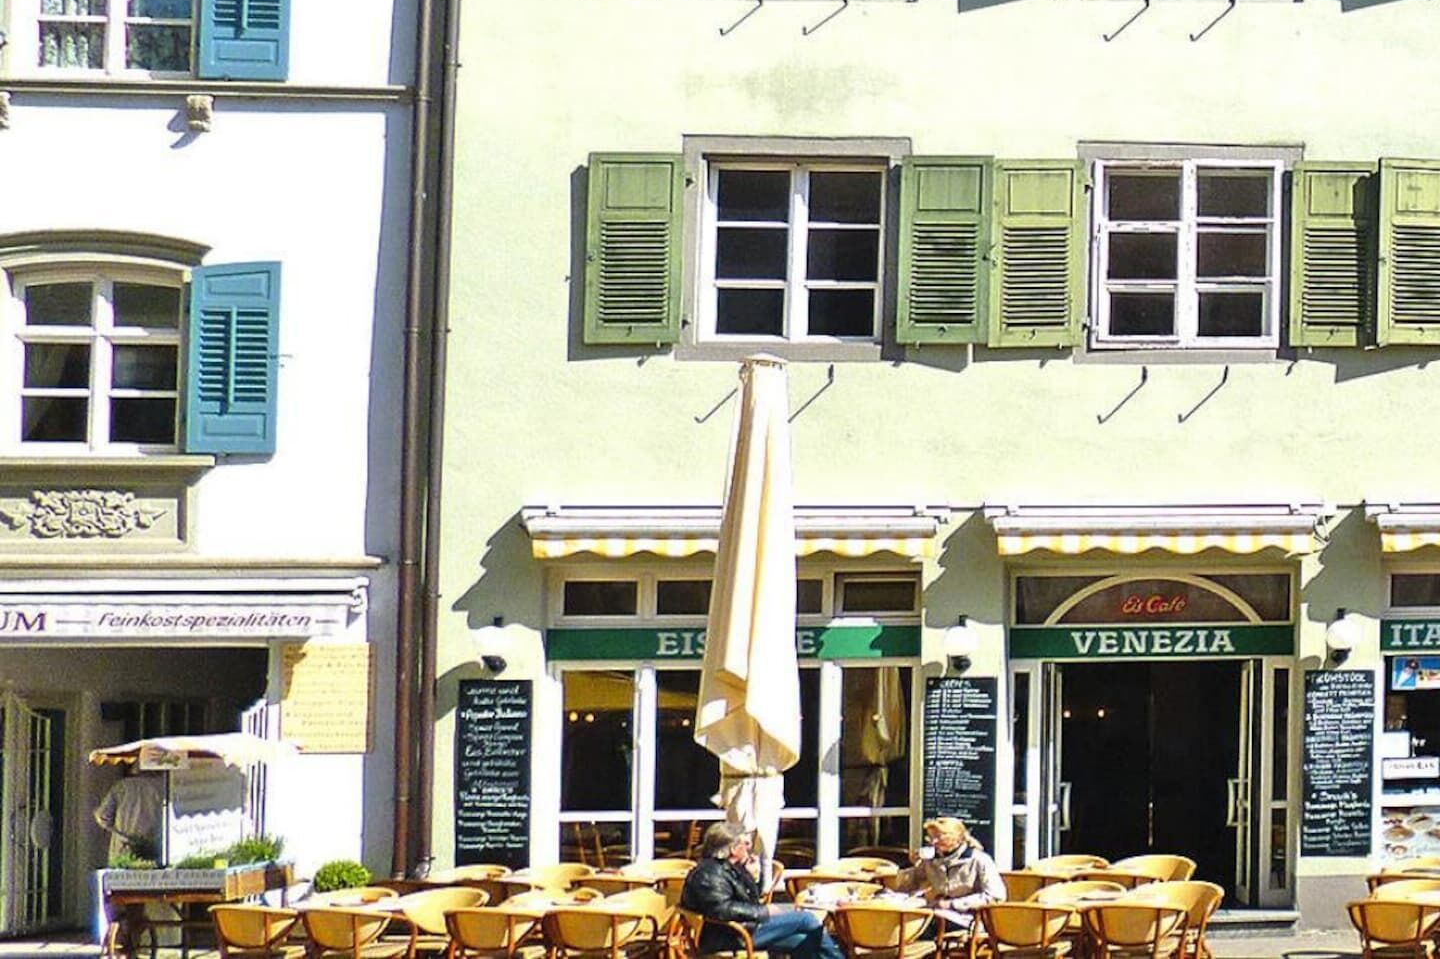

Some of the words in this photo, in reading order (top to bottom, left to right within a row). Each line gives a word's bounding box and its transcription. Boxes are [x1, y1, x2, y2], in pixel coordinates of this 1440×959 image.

[1122, 593, 1142, 614] Eis
[98, 611, 312, 630] Feinkostspezialitäten
[1070, 630, 1236, 654] VENEZIA
